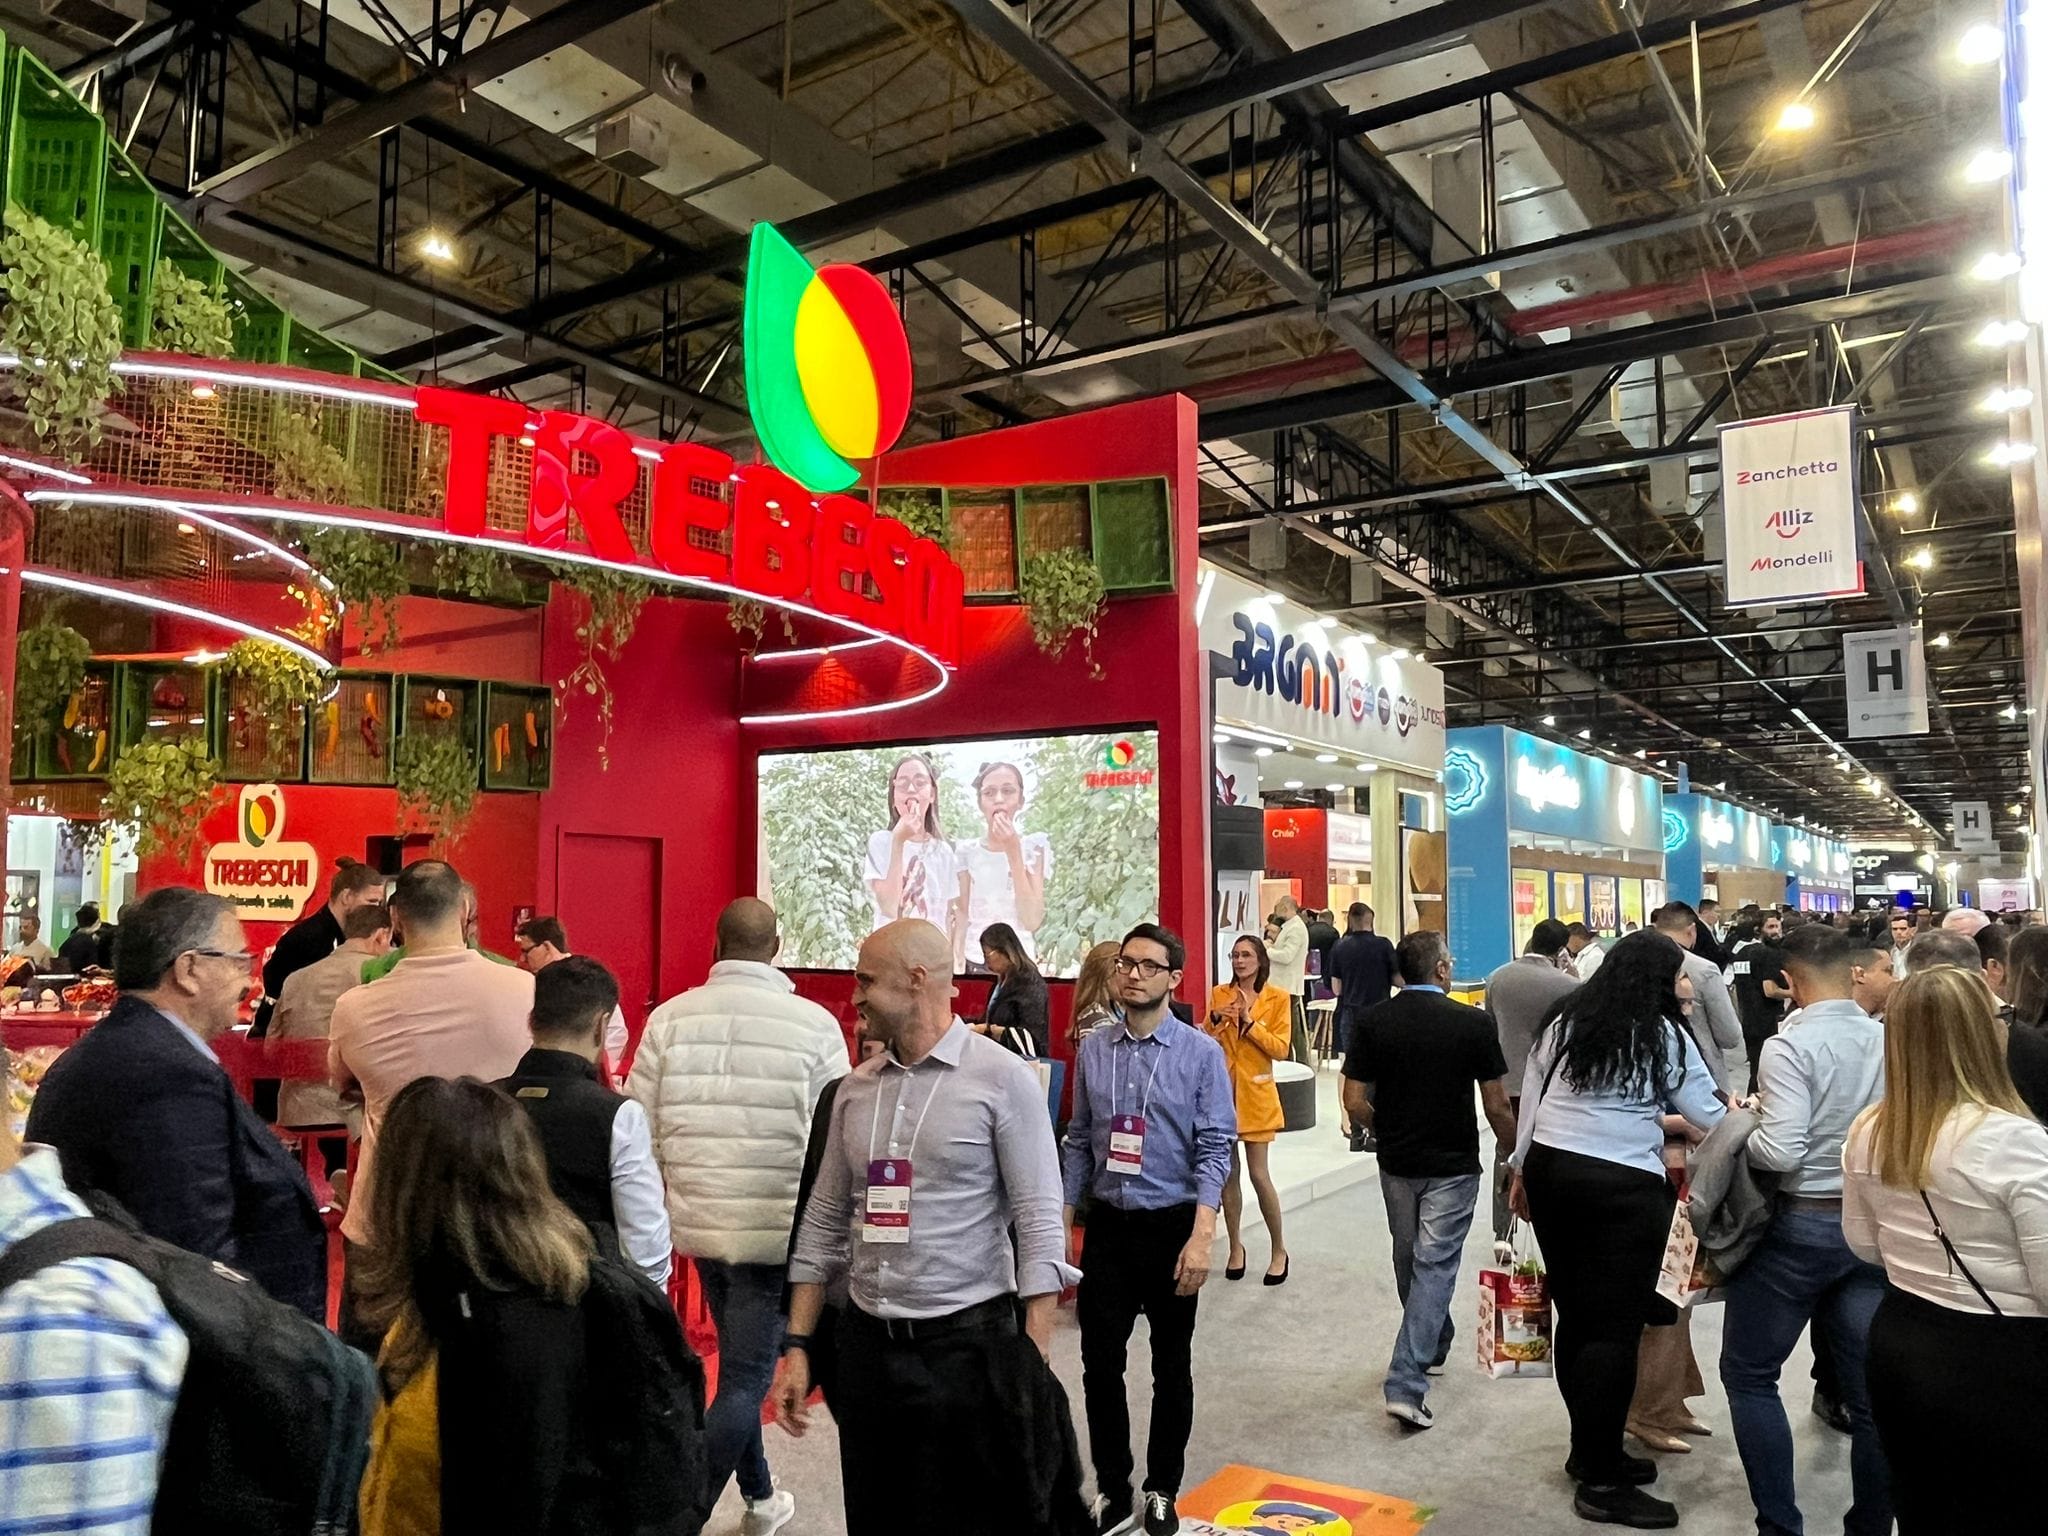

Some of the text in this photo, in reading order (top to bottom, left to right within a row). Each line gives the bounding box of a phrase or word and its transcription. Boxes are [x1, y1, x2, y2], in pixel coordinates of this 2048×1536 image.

[1737, 461, 1838, 485] Zanchetta
[1765, 509, 1814, 529] Alliz
[1750, 550, 1833, 571] Mondelli
[1867, 649, 1903, 692] H
[1963, 810, 1979, 829] H
[1272, 828, 1295, 839] Chile
[211, 858, 309, 888] TREBESCHI
